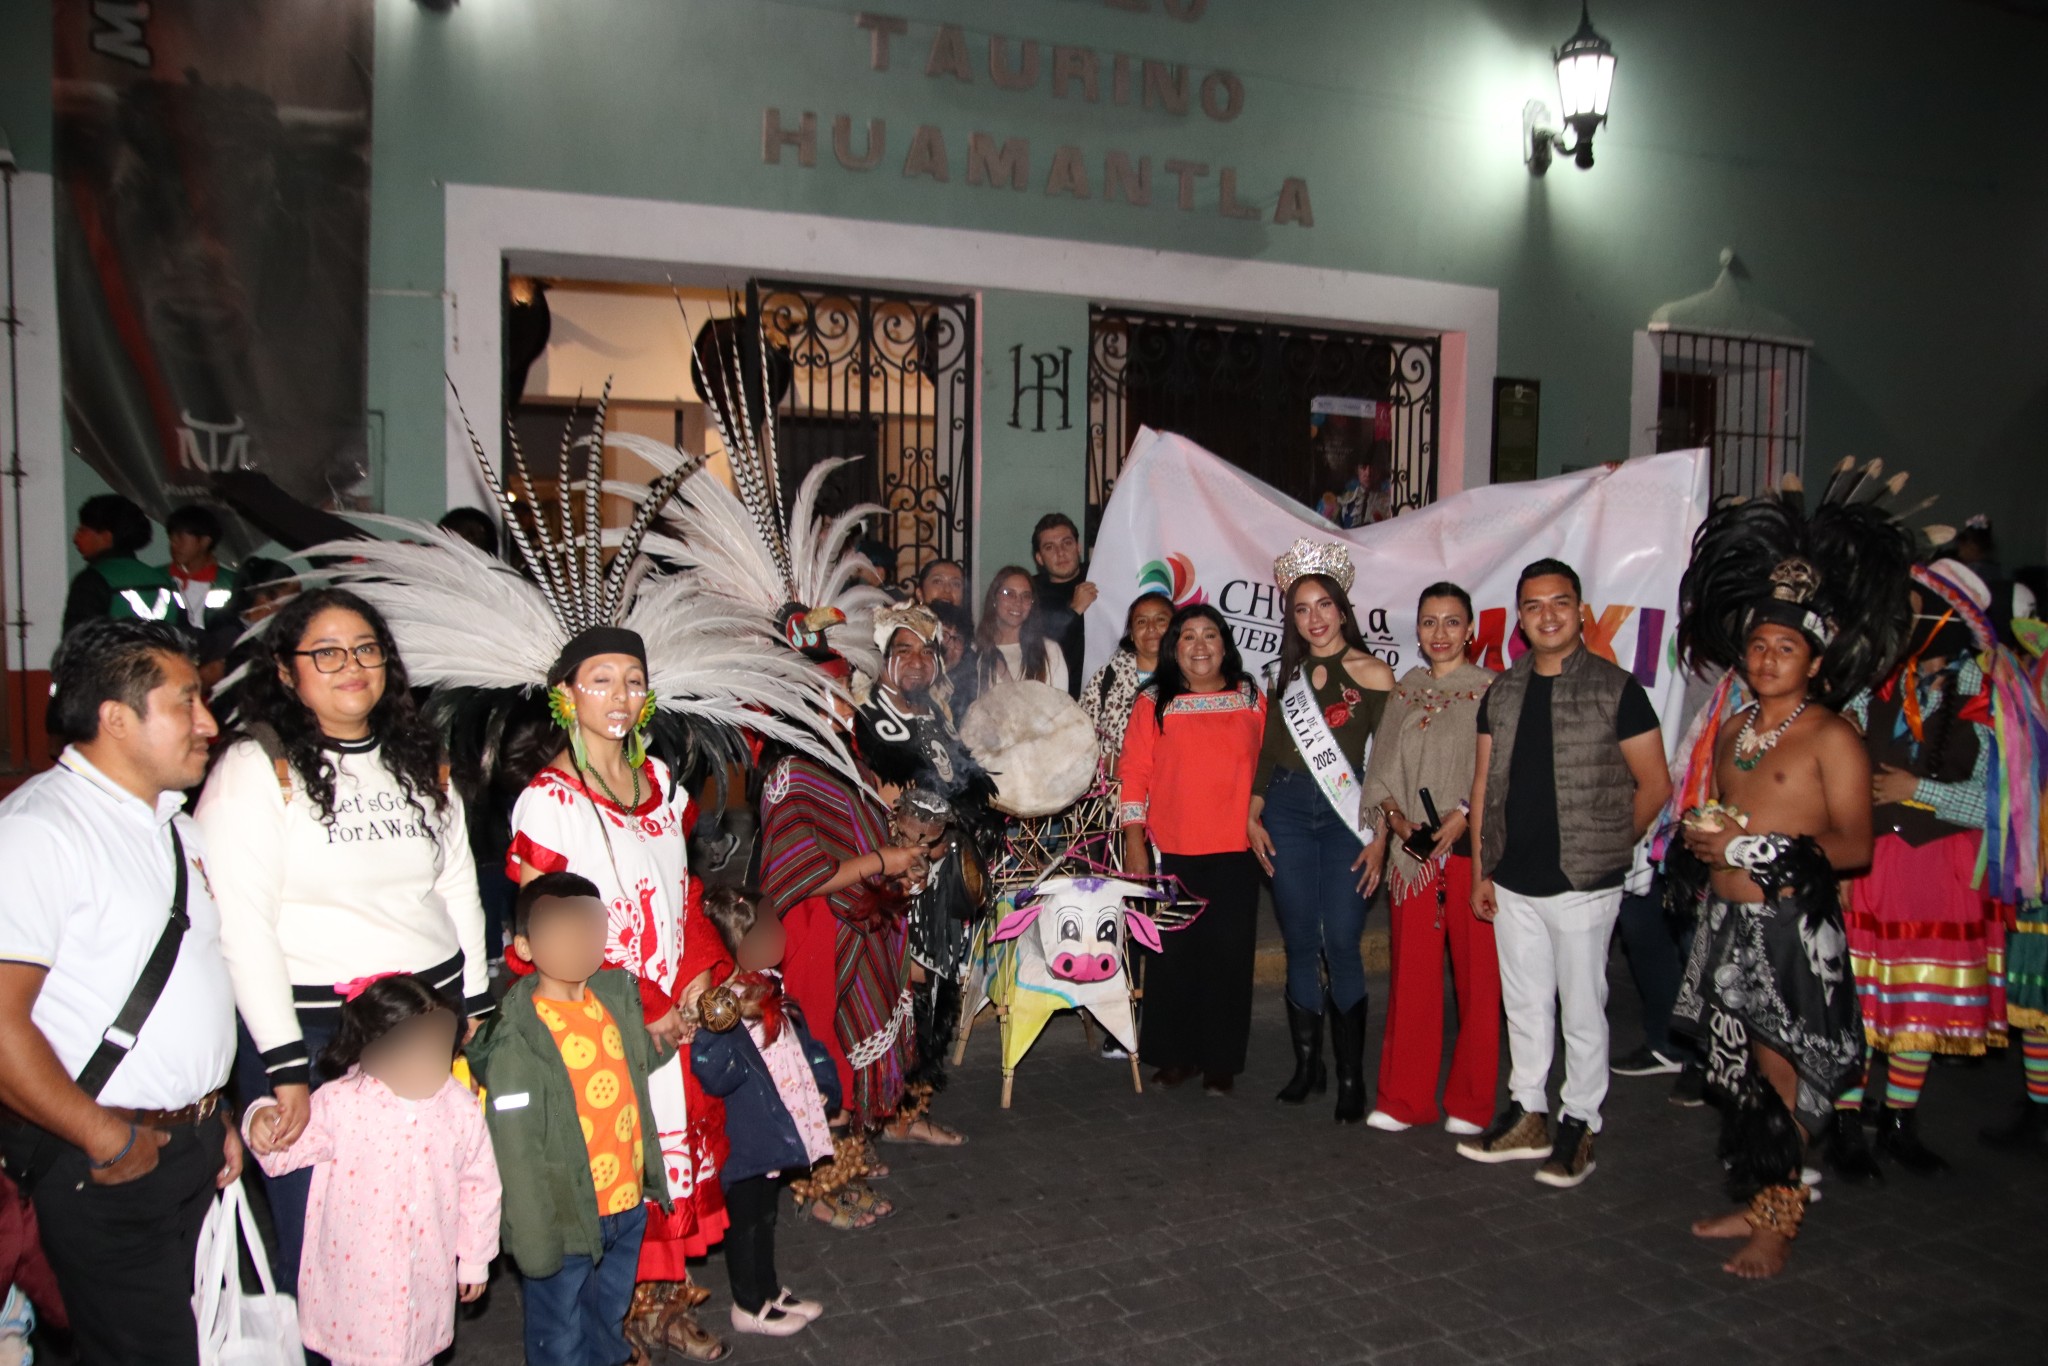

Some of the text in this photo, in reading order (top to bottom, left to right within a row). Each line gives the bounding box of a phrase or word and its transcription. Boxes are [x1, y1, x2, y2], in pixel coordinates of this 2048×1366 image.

[855, 11, 1245, 122] TAURINO
[761, 107, 1314, 228] HUAMANTLA
[1284, 696, 1315, 750] DALIA
[1295, 690, 1325, 743] REINA DE LA
[1312, 748, 1337, 771] 2025
